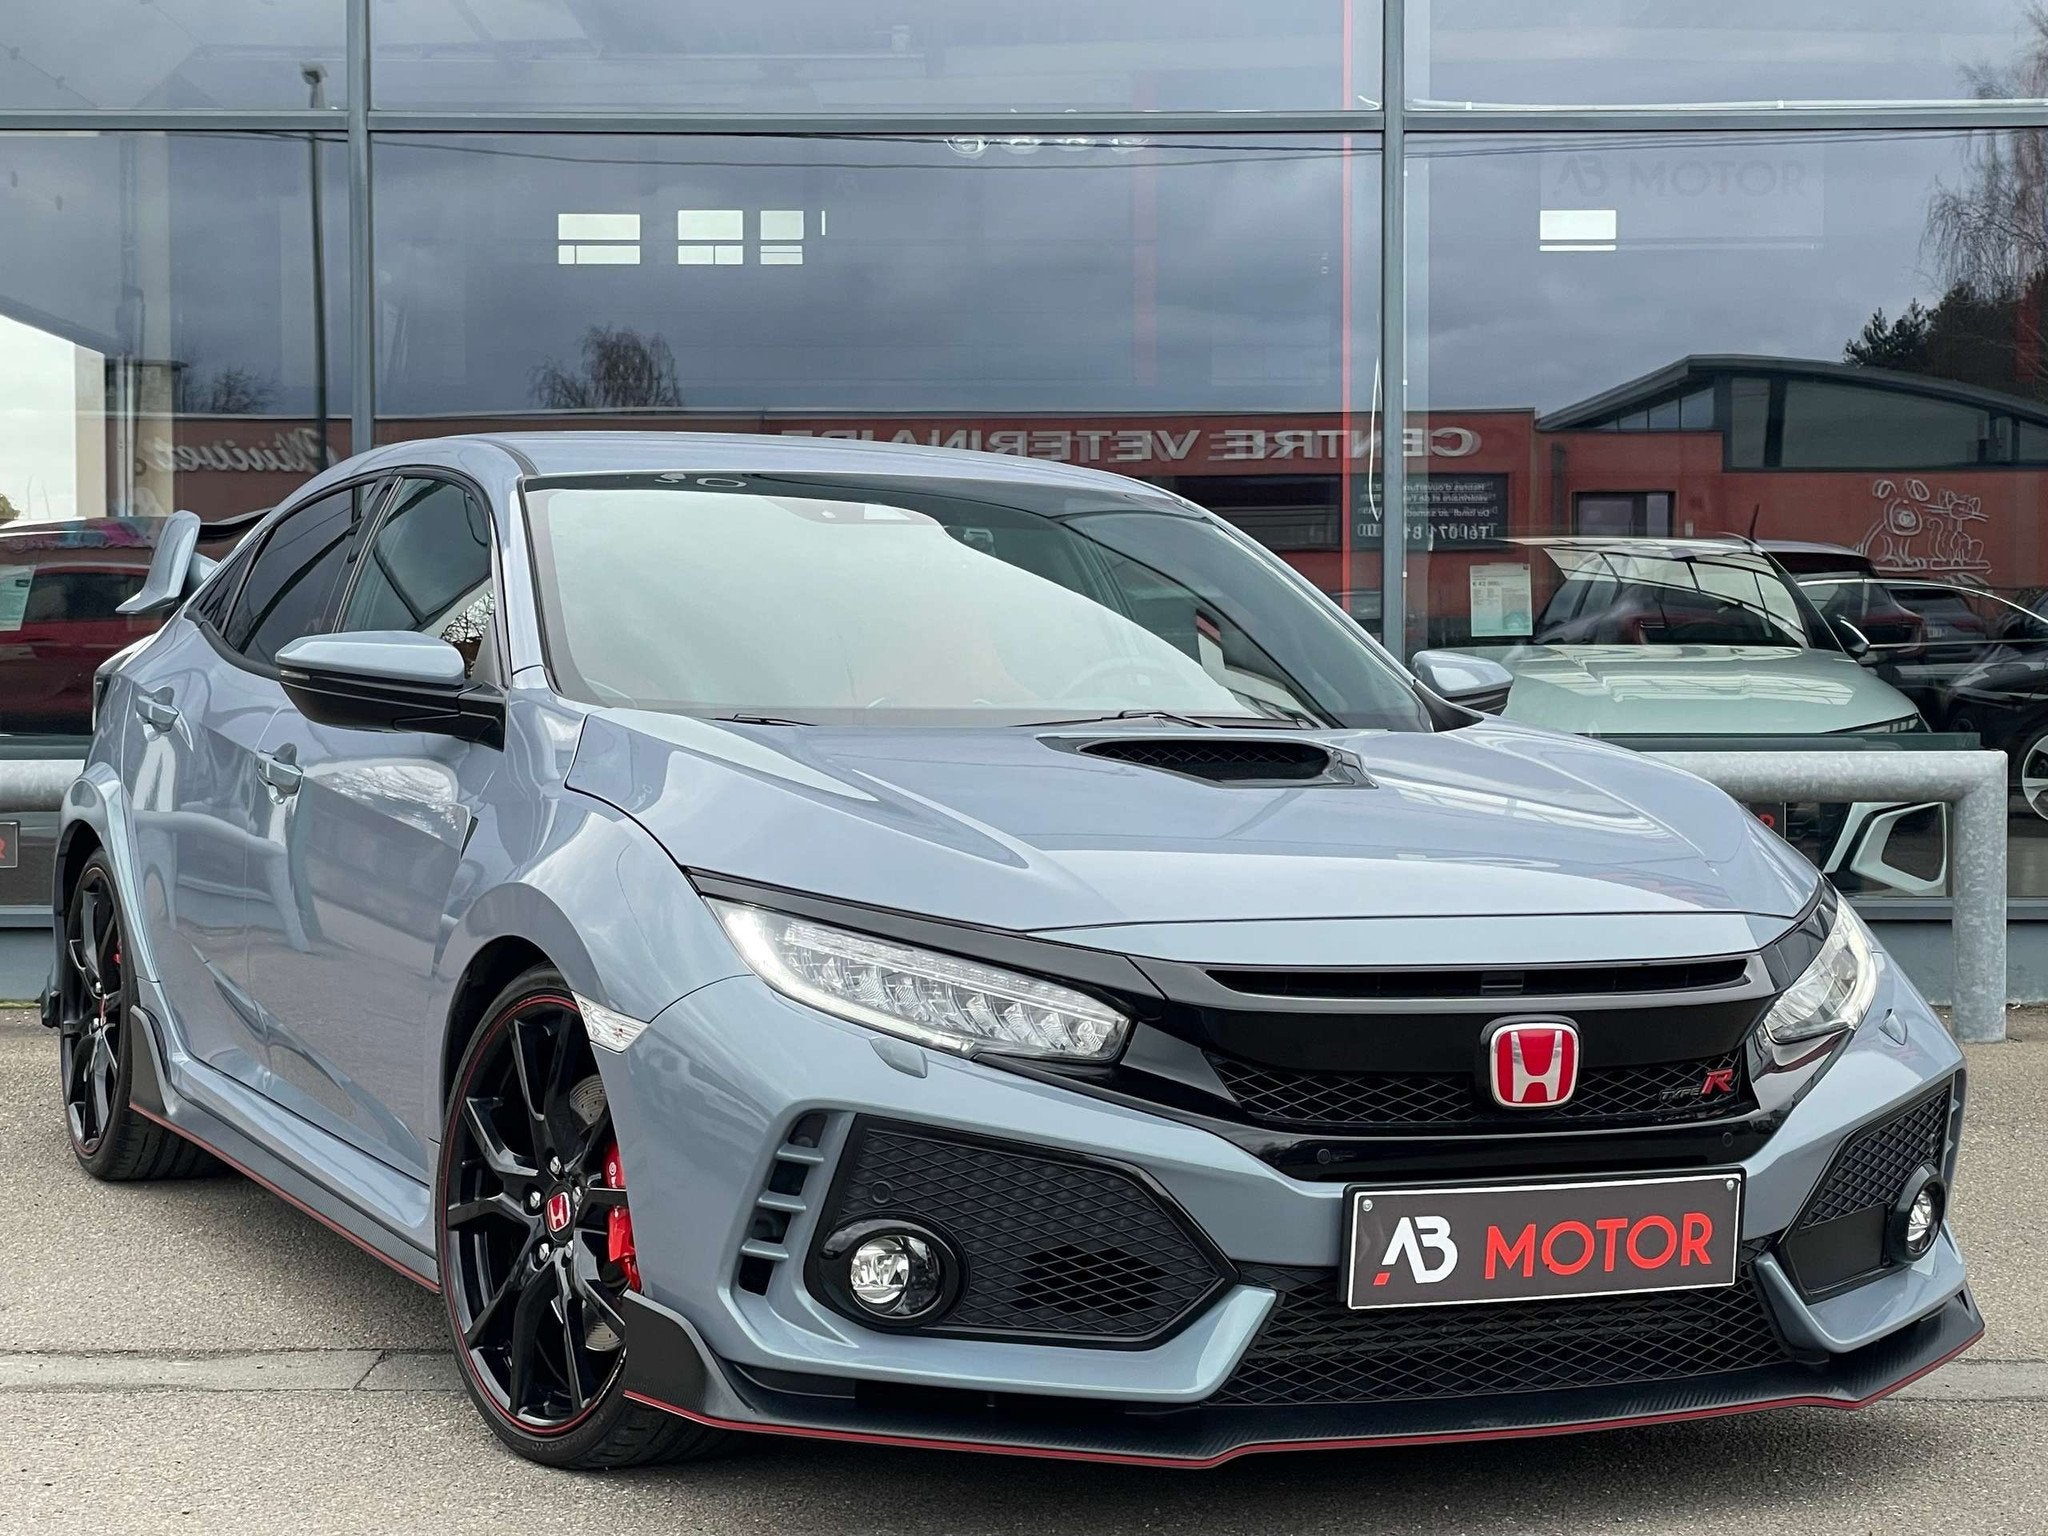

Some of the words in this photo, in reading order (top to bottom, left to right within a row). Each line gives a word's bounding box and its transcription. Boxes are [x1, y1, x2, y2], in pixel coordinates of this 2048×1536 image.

[1629, 158, 1806, 198] MOTOR
[1701, 1068, 1734, 1095] R
[1373, 1215, 1458, 1284] AB
[1485, 1212, 1713, 1280] MOTOR
